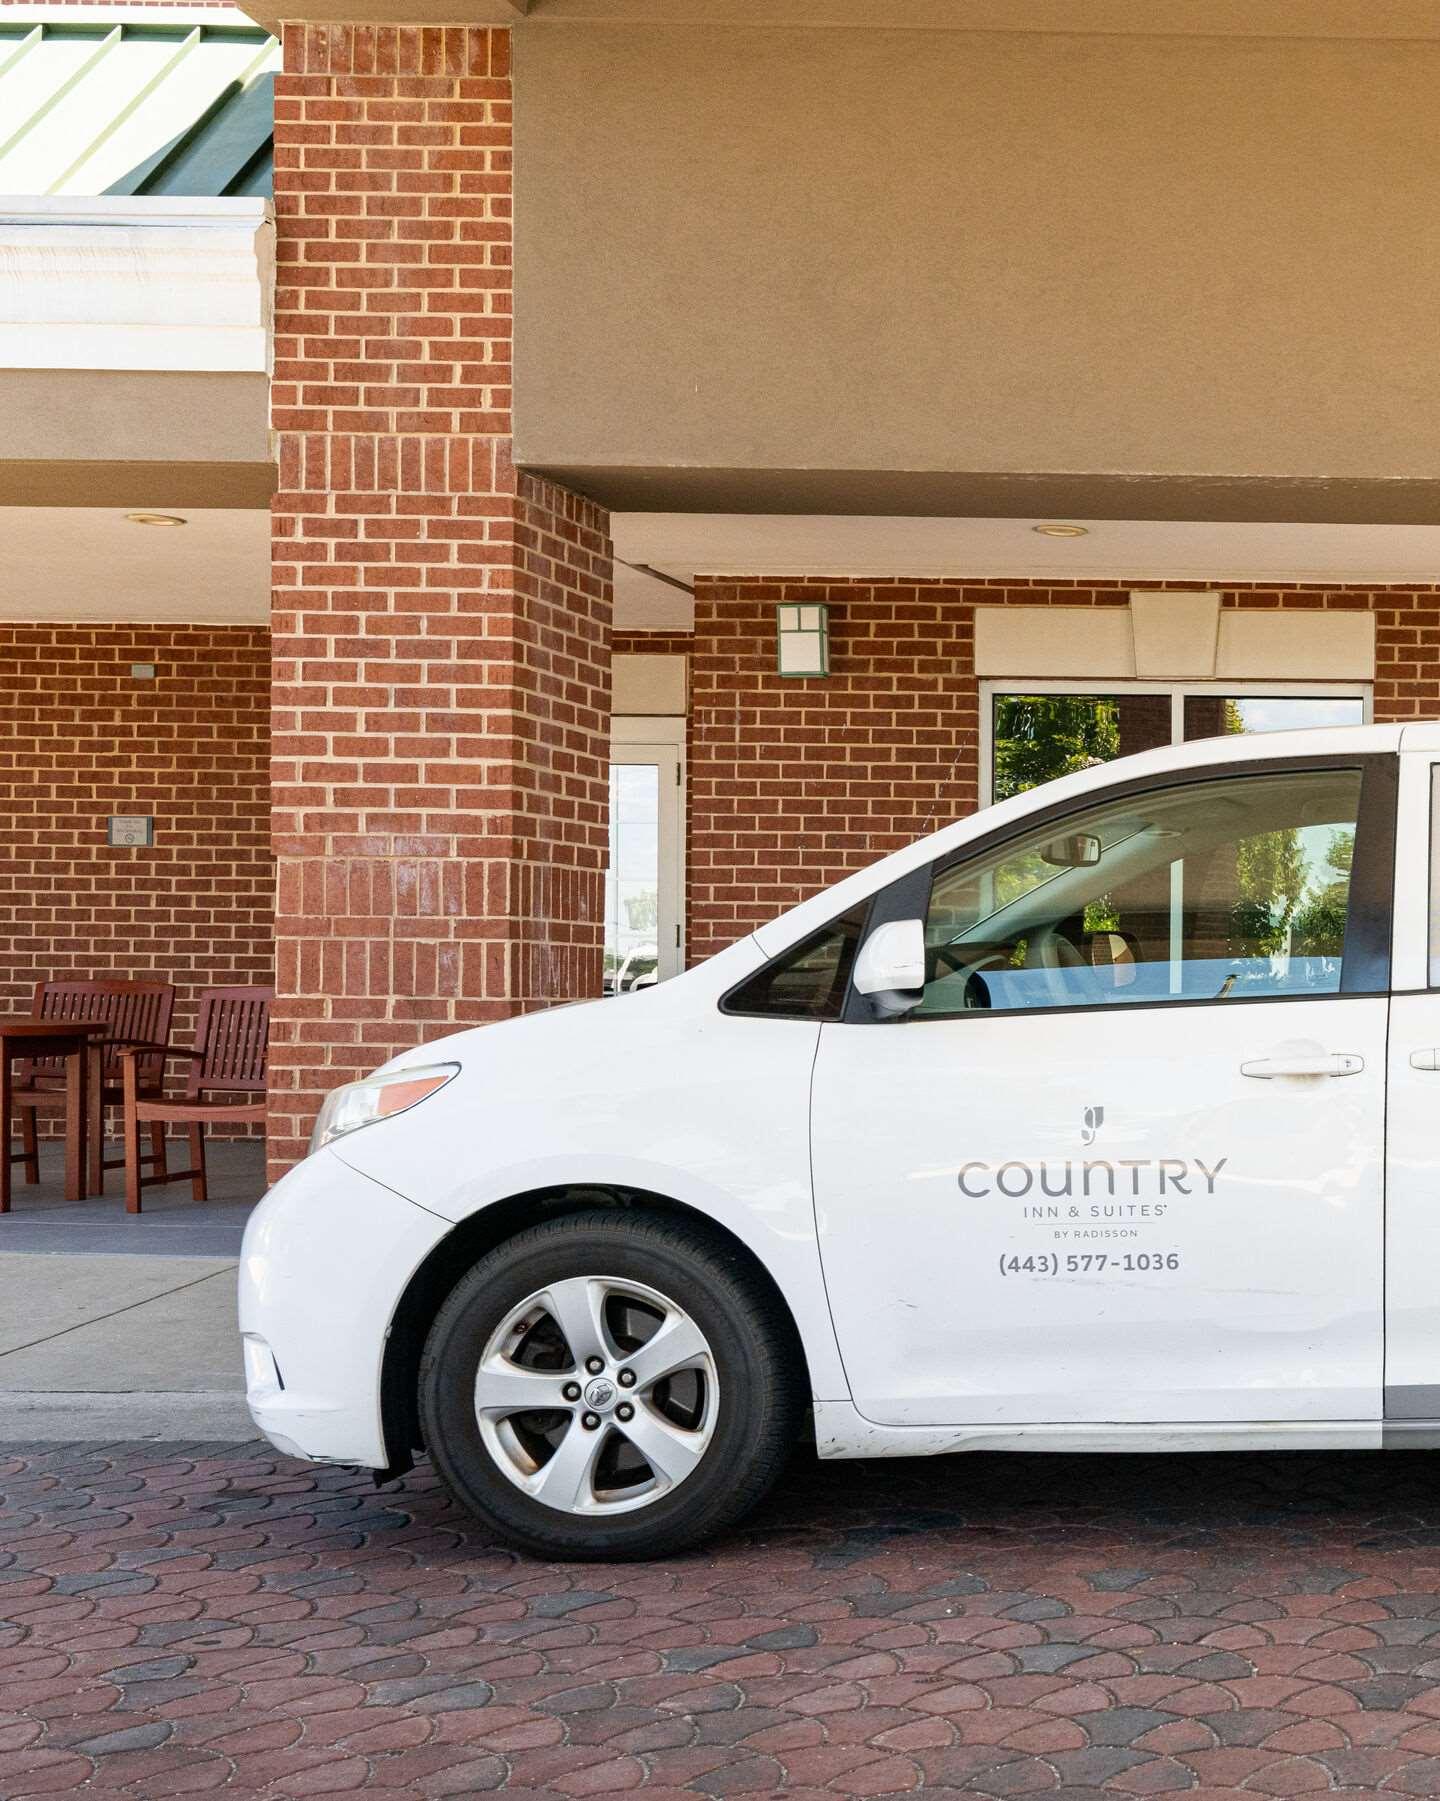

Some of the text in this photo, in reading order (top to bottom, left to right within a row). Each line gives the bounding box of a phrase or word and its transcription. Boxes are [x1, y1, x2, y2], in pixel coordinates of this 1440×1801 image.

[1023, 1204, 1165, 1218] INN & SUITES
[1054, 1229, 1138, 1239] BY RADISSON
[999, 1253, 1180, 1276] (443) 577-1036
